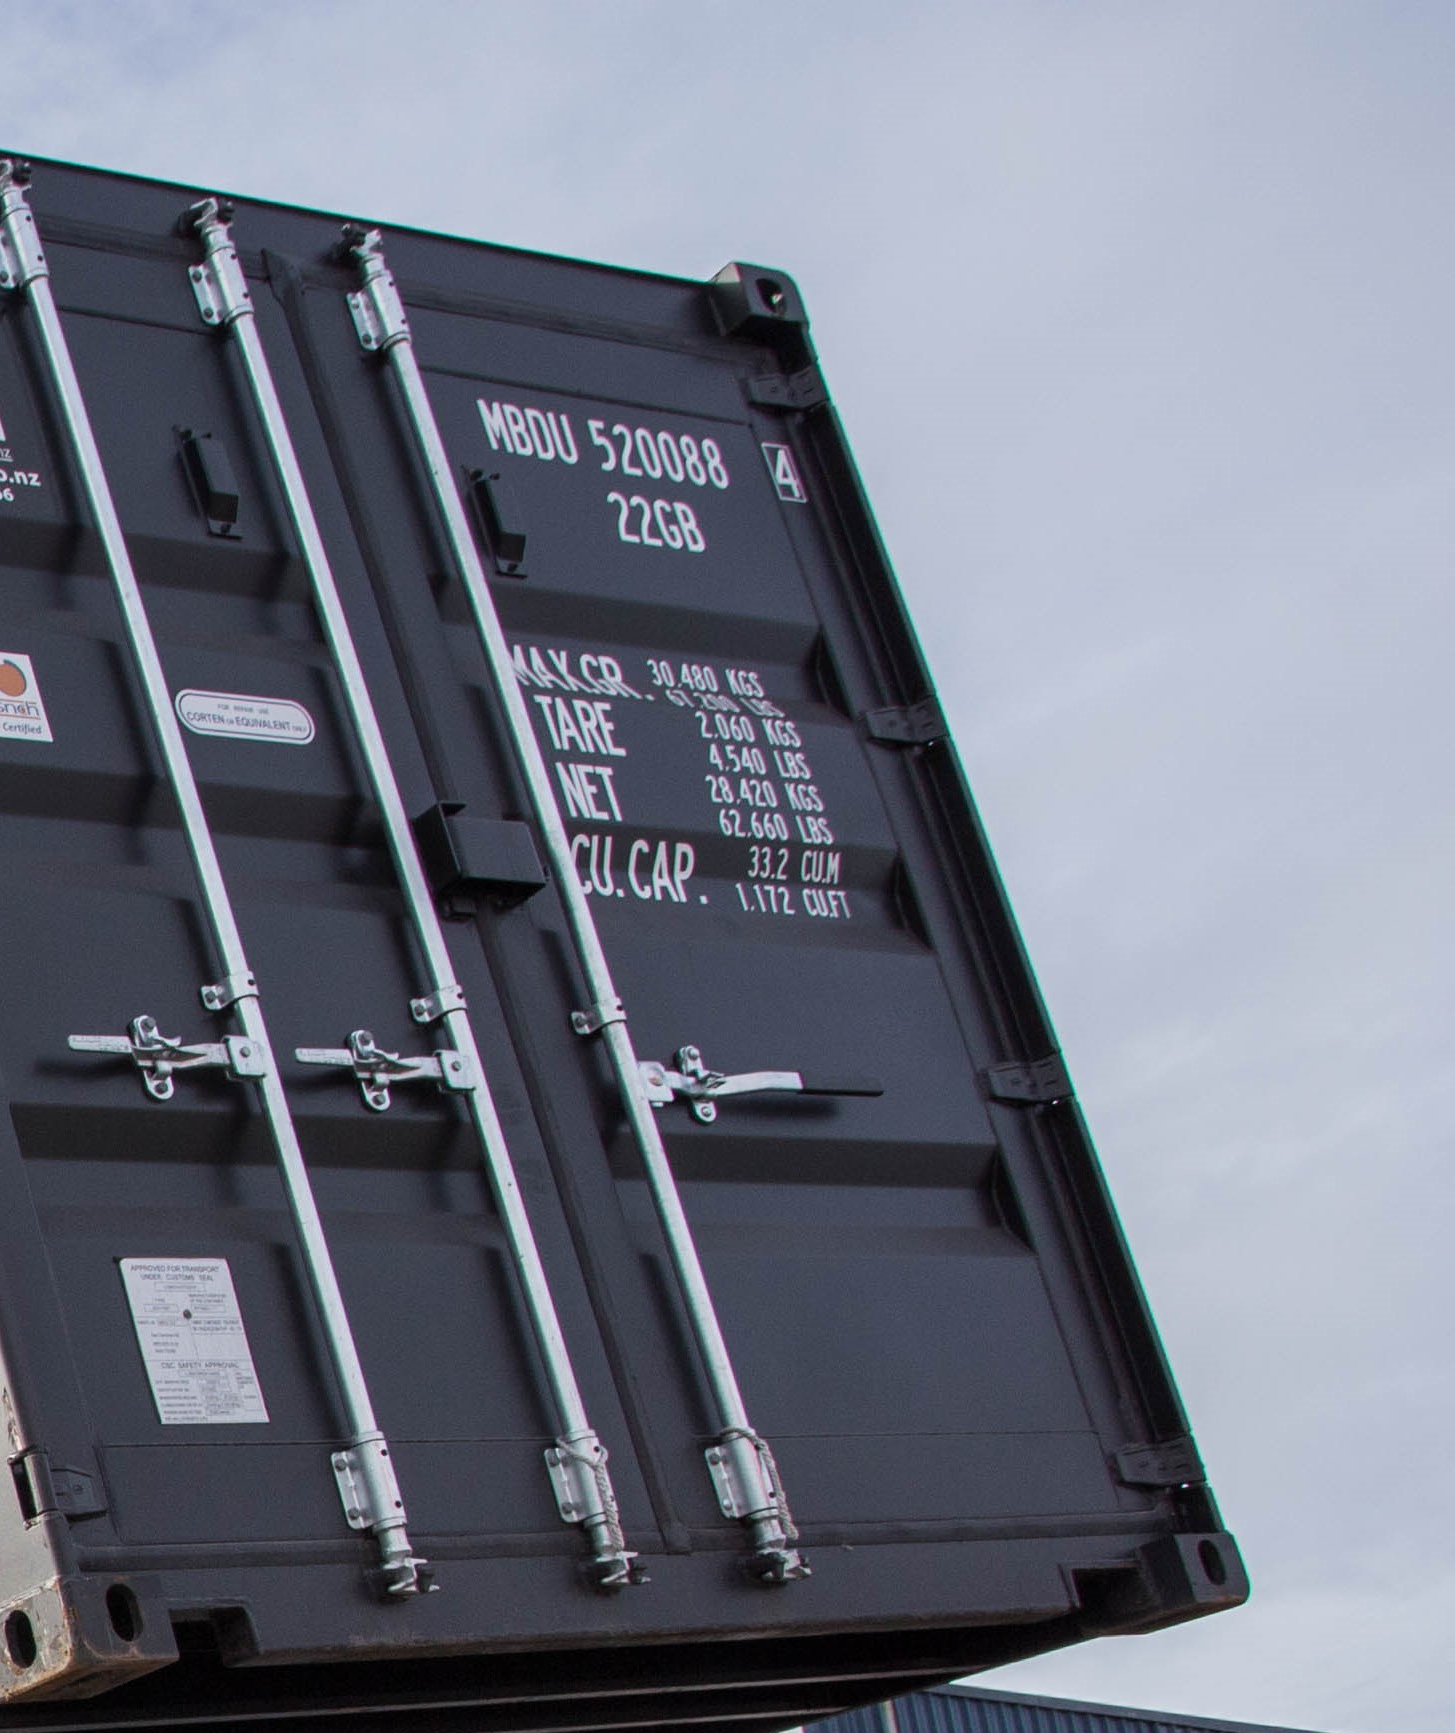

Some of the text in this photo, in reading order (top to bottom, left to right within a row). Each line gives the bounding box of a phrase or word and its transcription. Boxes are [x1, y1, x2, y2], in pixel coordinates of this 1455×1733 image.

[476, 398, 579, 465] MBDU
[587, 419, 729, 490] 520088
[606, 491, 706, 553] 22GB
[647, 659, 717, 693] 30.480
[726, 667, 766, 698] KGS
[186, 711, 225, 725] CORTEN
[235, 716, 291, 733] EQUIVALENT
[534, 694, 802, 757] TARE 2.060 KGS
[739, 697, 786, 718] LBS
[2, 722, 42, 736] Certified
[709, 744, 811, 781] 4.540 LBS
[555, 762, 824, 822] NET 28.420 KGS
[719, 808, 834, 846] 62.660 LBS
[747, 846, 788, 882] 33.2
[735, 883, 795, 914] 1.172
